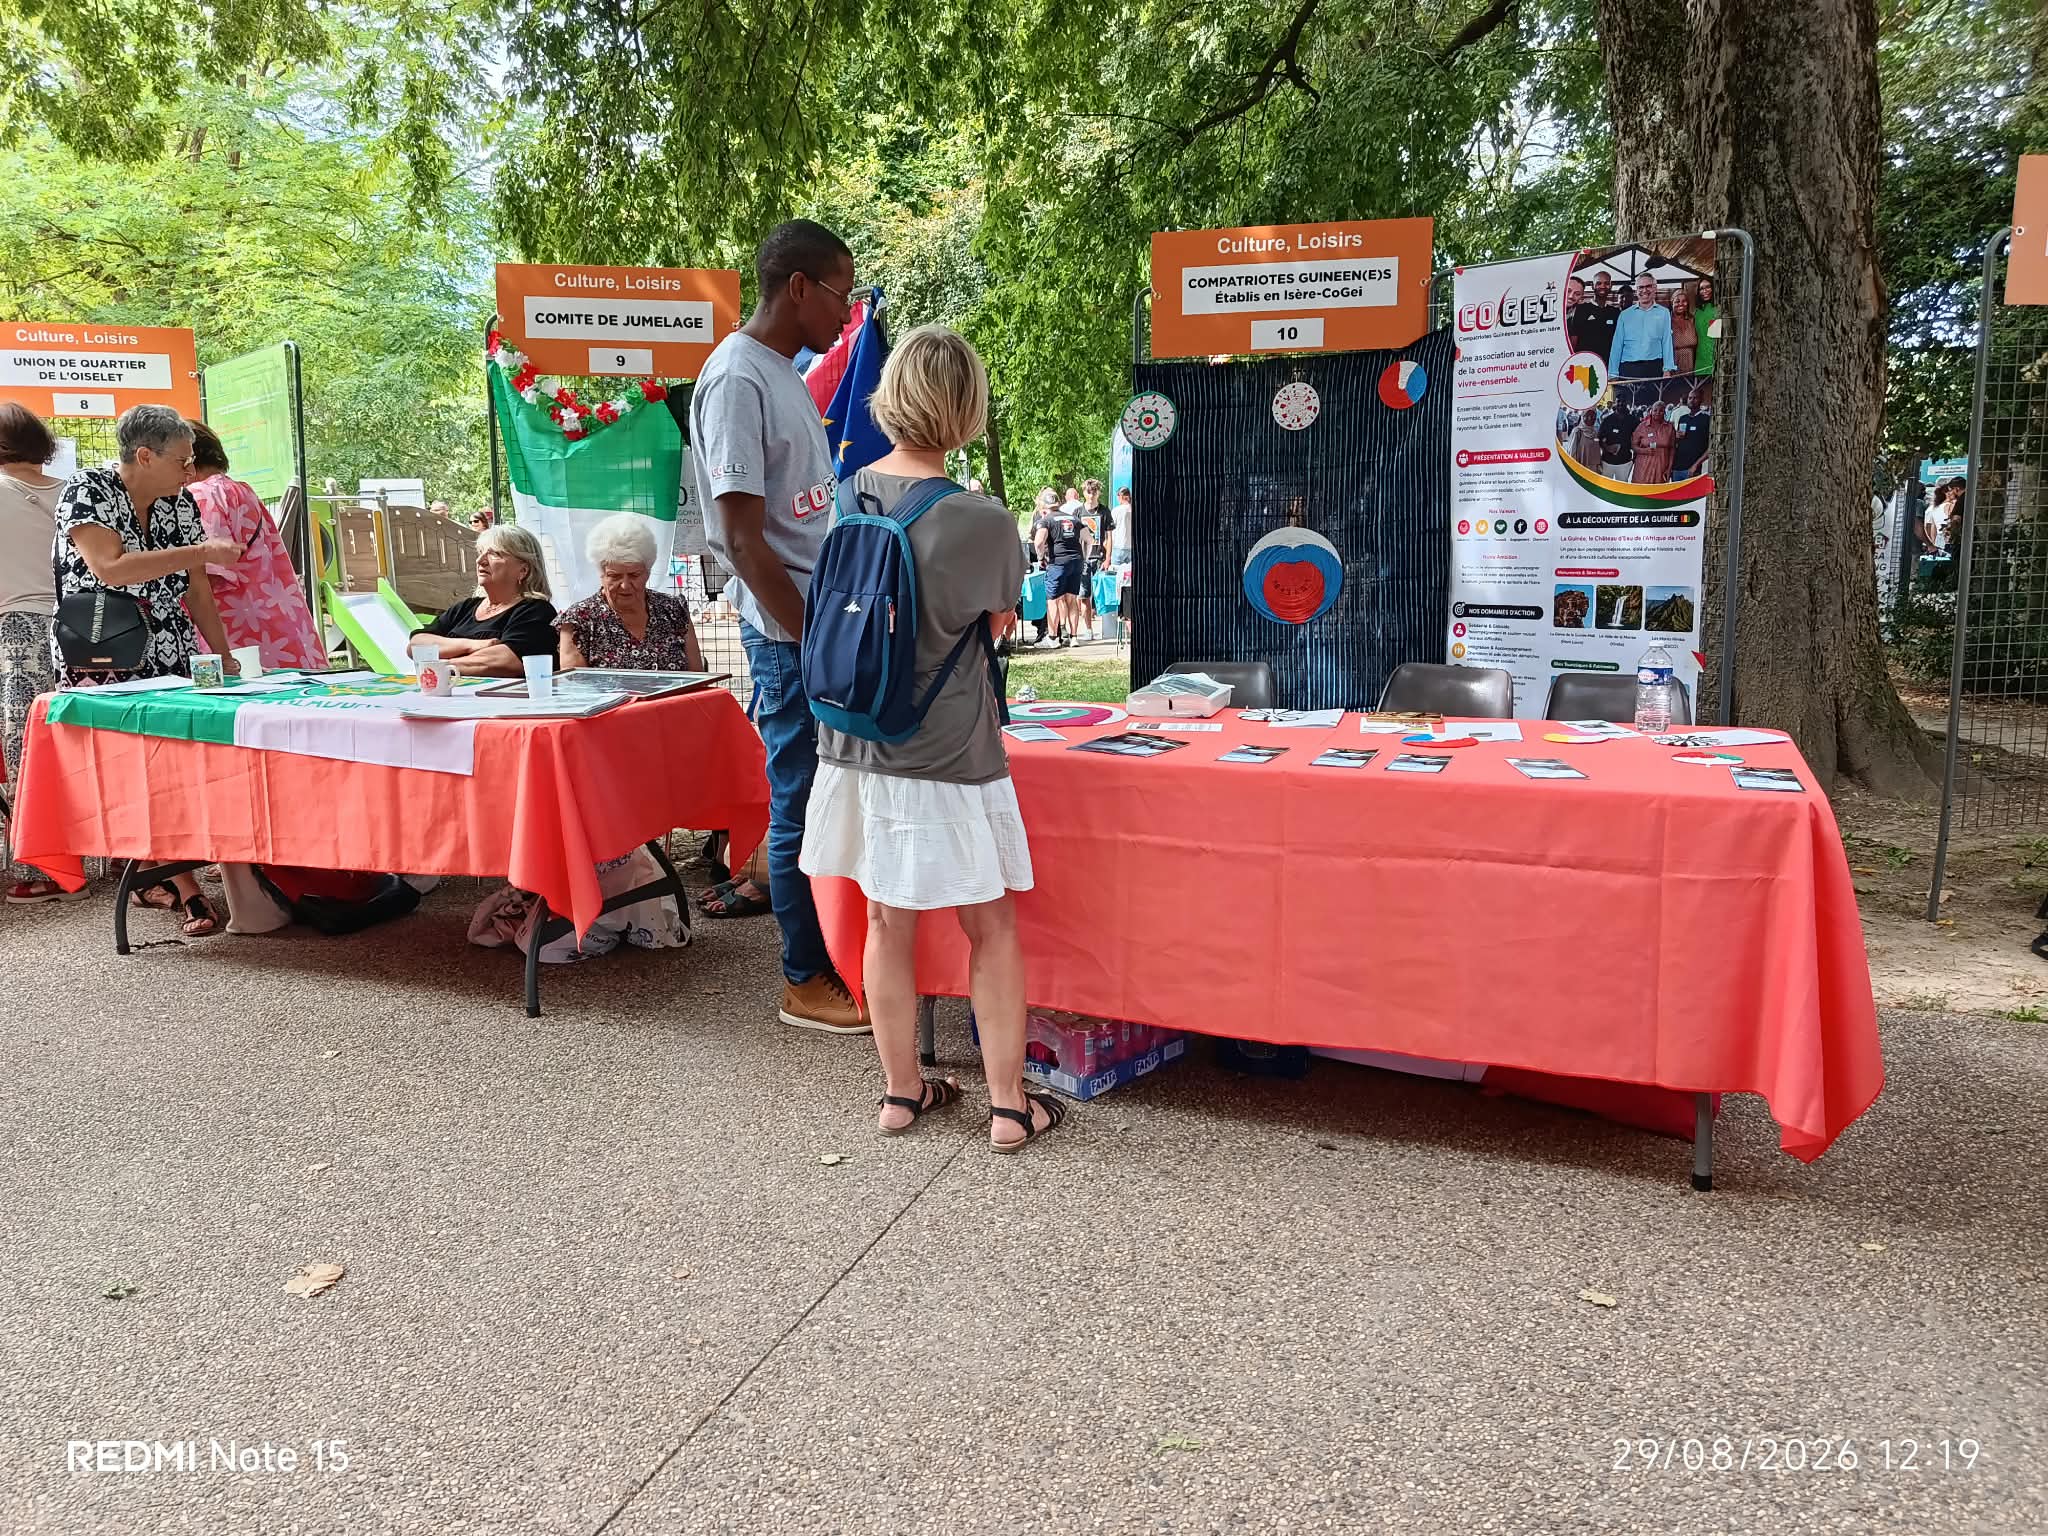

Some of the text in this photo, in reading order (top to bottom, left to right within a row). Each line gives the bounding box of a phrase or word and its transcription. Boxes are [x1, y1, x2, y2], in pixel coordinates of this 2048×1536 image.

[1217, 231, 1363, 254] Culture, Loisirs
[554, 273, 681, 291] Culture, Loisirs
[1188, 269, 1392, 288] COMPATRIOTES GUINEEN(E)S
[1215, 286, 1363, 304] Établis en Isère-CoGei
[1458, 291, 1558, 332] COGEI
[535, 312, 703, 329] COMITE DE JUMELAGE
[16, 329, 139, 345] Culture, Loisirs
[1277, 327, 1298, 340] 10
[616, 355, 625, 366] 9
[1474, 351, 1515, 361] association
[1527, 347, 1555, 356] service
[13, 357, 146, 369] UNION DE QUARTIER
[1458, 368, 1467, 376] de
[1477, 362, 1528, 374] communauté
[1530, 361, 1537, 369] et
[1539, 360, 1549, 368] du
[39, 371, 123, 382] DE L'OISELET
[1457, 376, 1521, 388] vivre-ensemble.
[80, 399, 89, 410] 8
[1566, 515, 1571, 524] À
[1582, 515, 1628, 524] DÉCOUVERTE
[1651, 514, 1678, 523] GUINÉE
[1480, 608, 1509, 616] DOMAINES
[1134, 1053, 1160, 1075] FANTA
[1090, 1070, 1117, 1094] FANTA
